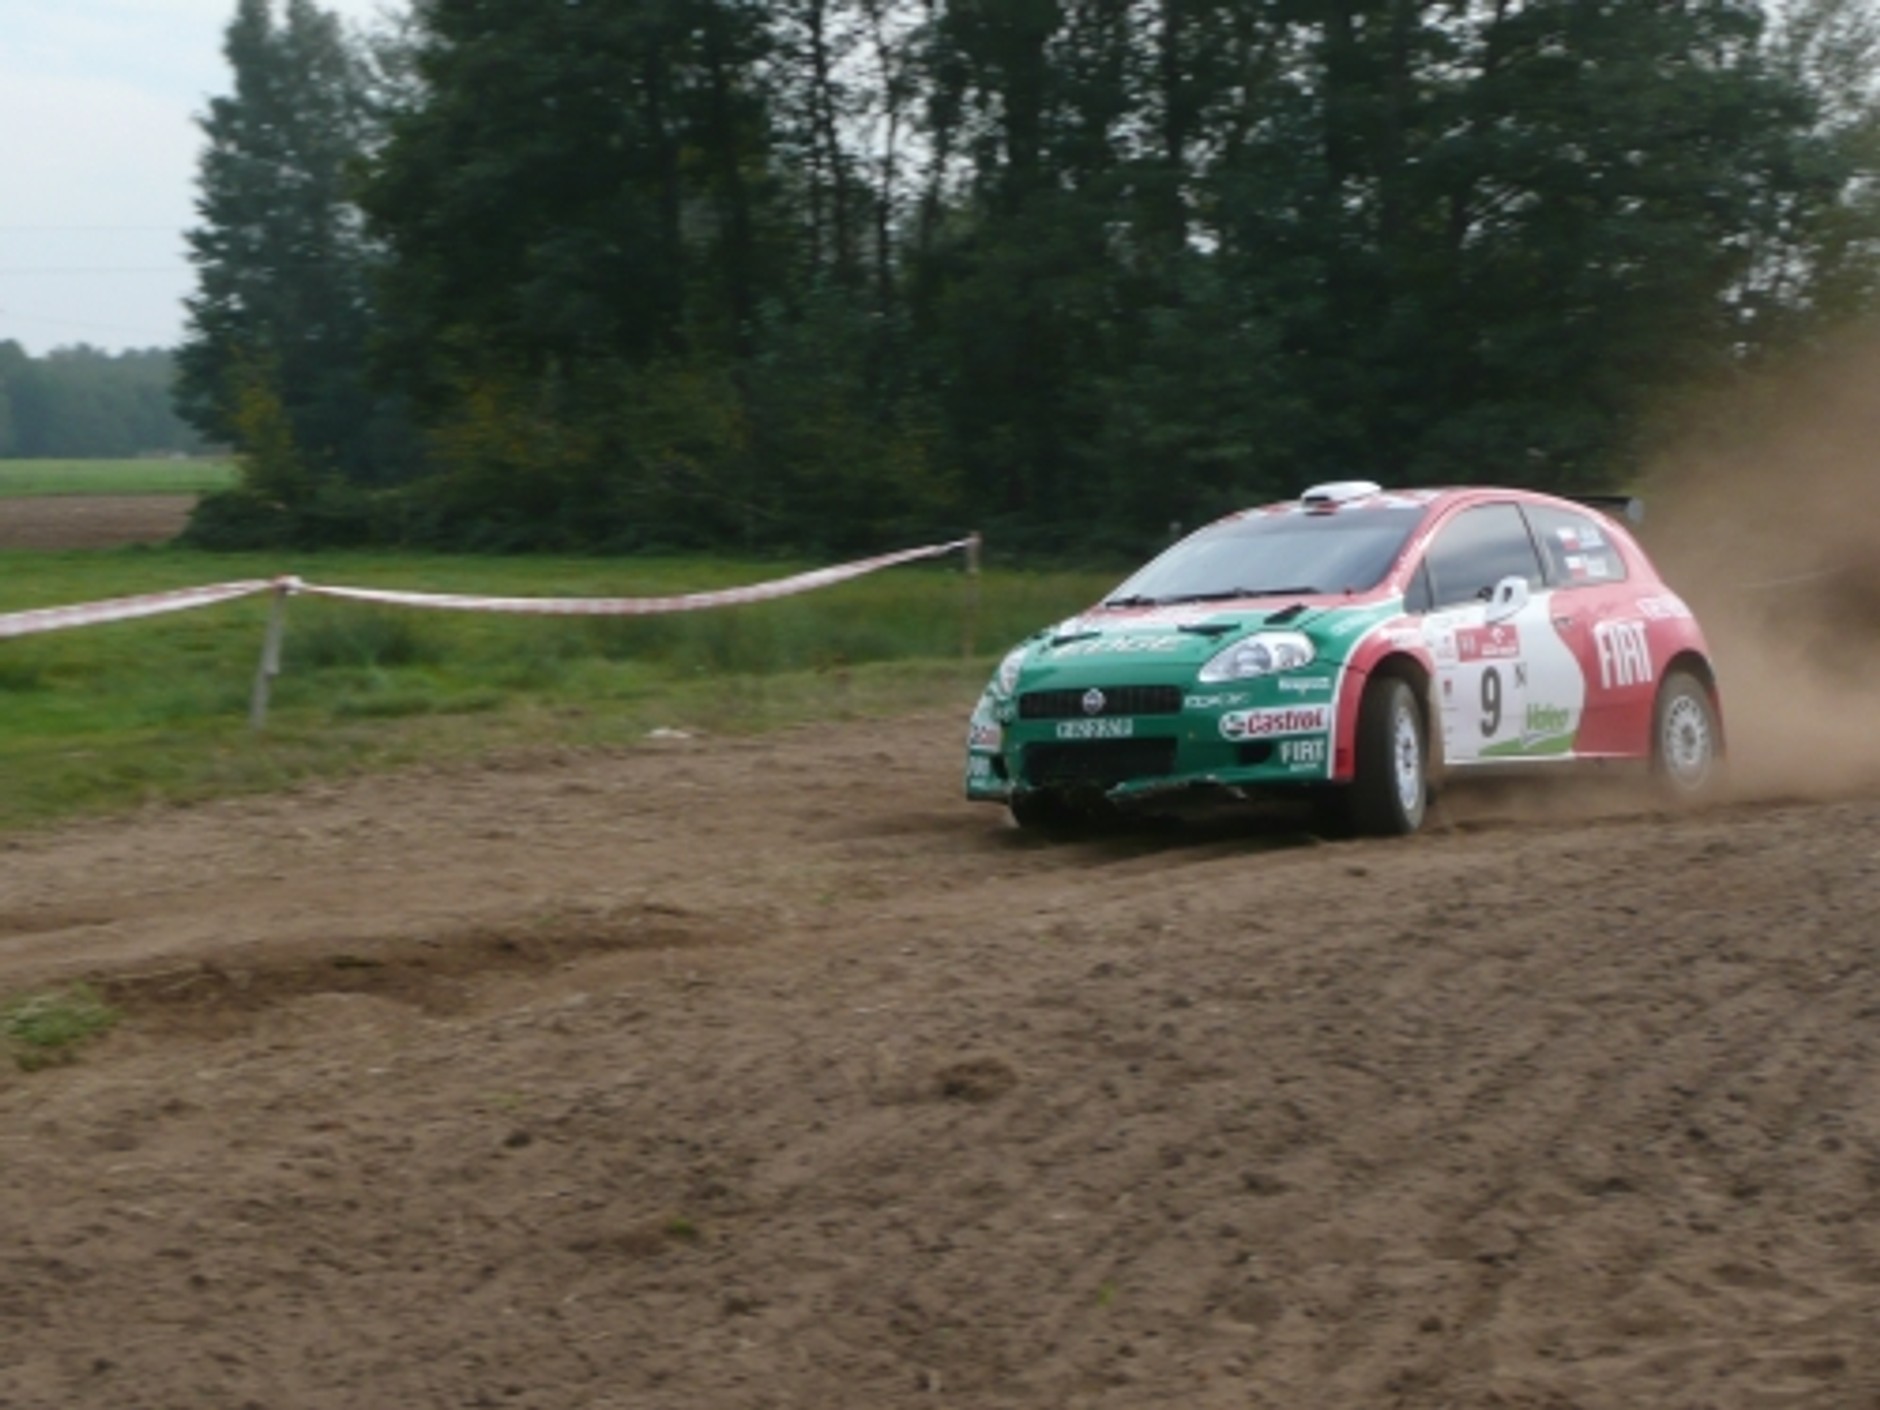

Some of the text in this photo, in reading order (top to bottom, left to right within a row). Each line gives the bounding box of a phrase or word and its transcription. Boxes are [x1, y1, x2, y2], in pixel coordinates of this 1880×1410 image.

[1594, 620, 1652, 689] FIAT
[1248, 707, 1324, 735] Castrol
[1480, 666, 1501, 738] 9
[1280, 737, 1325, 764] FIAT
